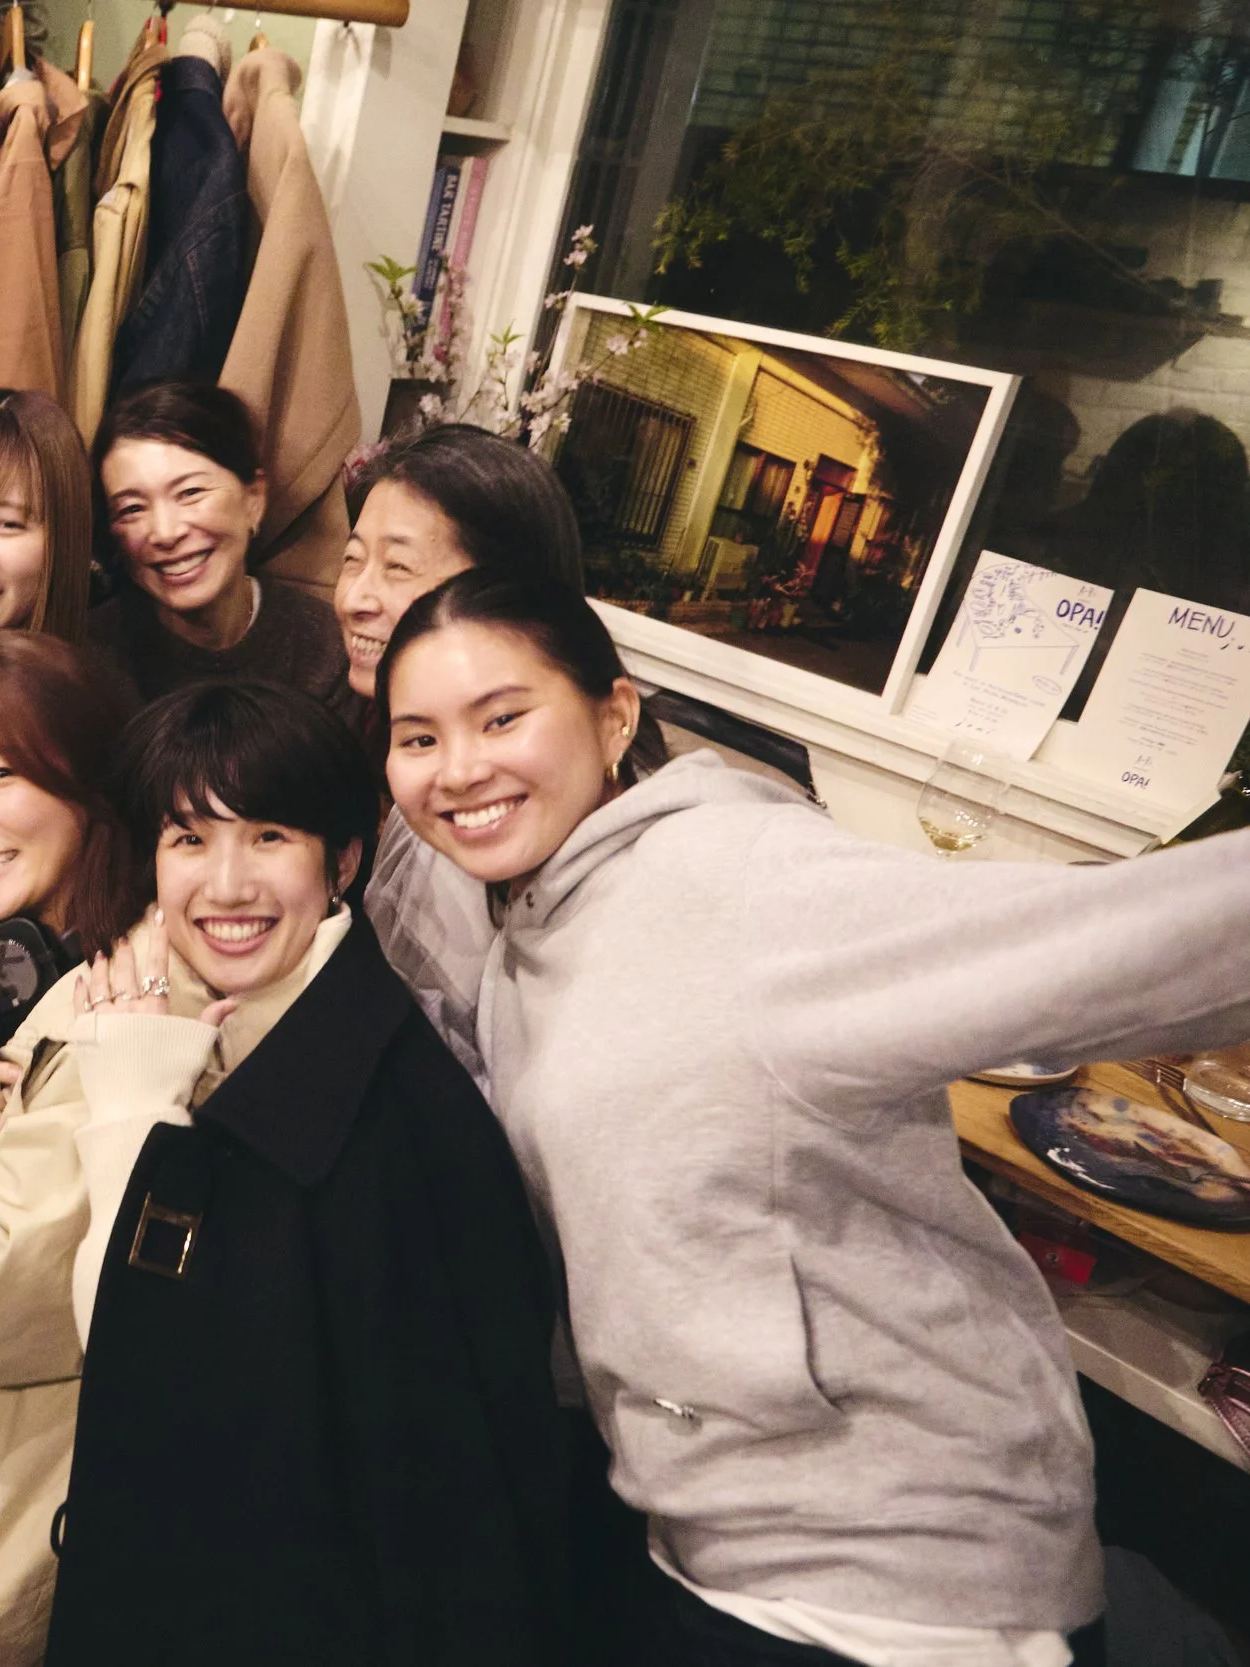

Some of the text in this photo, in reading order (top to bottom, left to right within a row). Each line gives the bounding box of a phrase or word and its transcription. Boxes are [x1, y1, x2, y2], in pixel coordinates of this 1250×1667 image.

[1056, 599, 1105, 630] OPA!
[1168, 606, 1235, 639] MENU
[1121, 771, 1150, 790] OPA!
